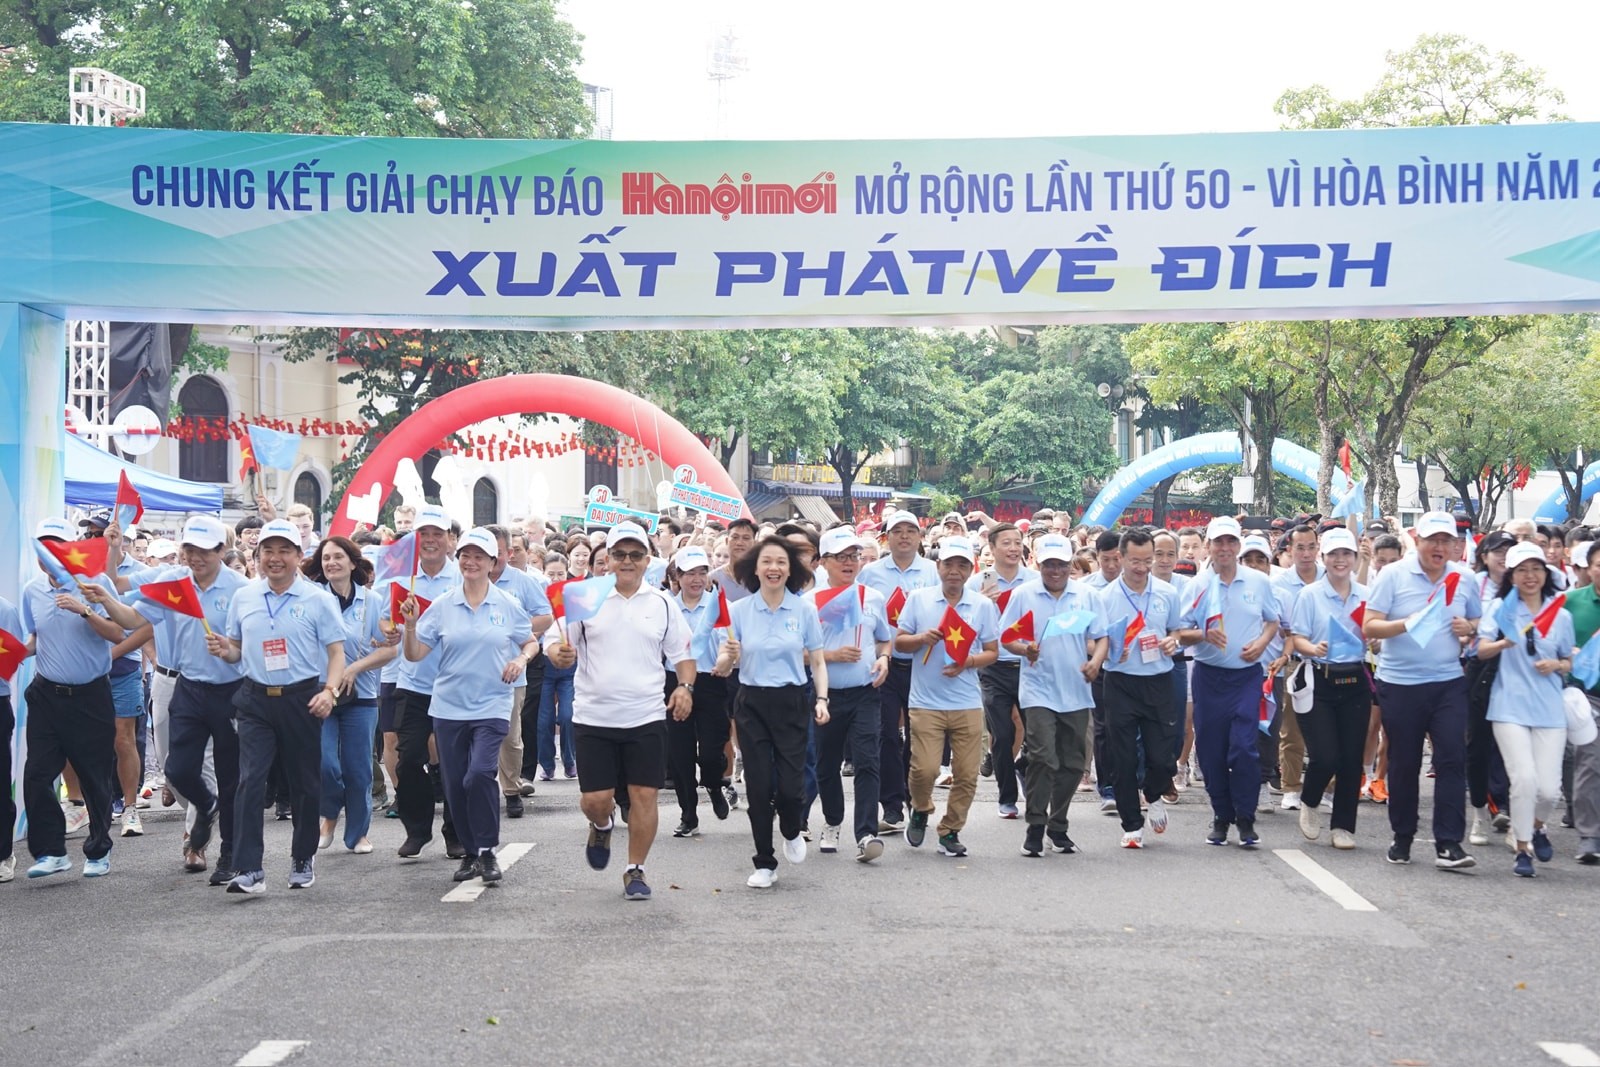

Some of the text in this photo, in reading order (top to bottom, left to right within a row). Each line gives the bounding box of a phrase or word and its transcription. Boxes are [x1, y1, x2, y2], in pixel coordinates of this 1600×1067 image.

[131, 164, 255, 209] CHUNG
[267, 158, 335, 212] KẾT
[346, 160, 415, 214] GIẢI
[427, 174, 521, 224] CHẠY
[534, 167, 603, 216] BÁO
[855, 161, 910, 215] MỞ
[920, 165, 1013, 222] RỘNG
[1026, 159, 1092, 212] LẦN
[1104, 162, 1175, 211] THỨ
[1185, 169, 1230, 209] 50
[1267, 159, 1300, 208] VÌ
[1314, 158, 1386, 207] HÒA
[1398, 156, 1483, 205] BÌNH
[1497, 152, 1578, 201] NĂM
[426, 226, 677, 297] XUẤT
[1151, 227, 1392, 291] ĐÍCH
